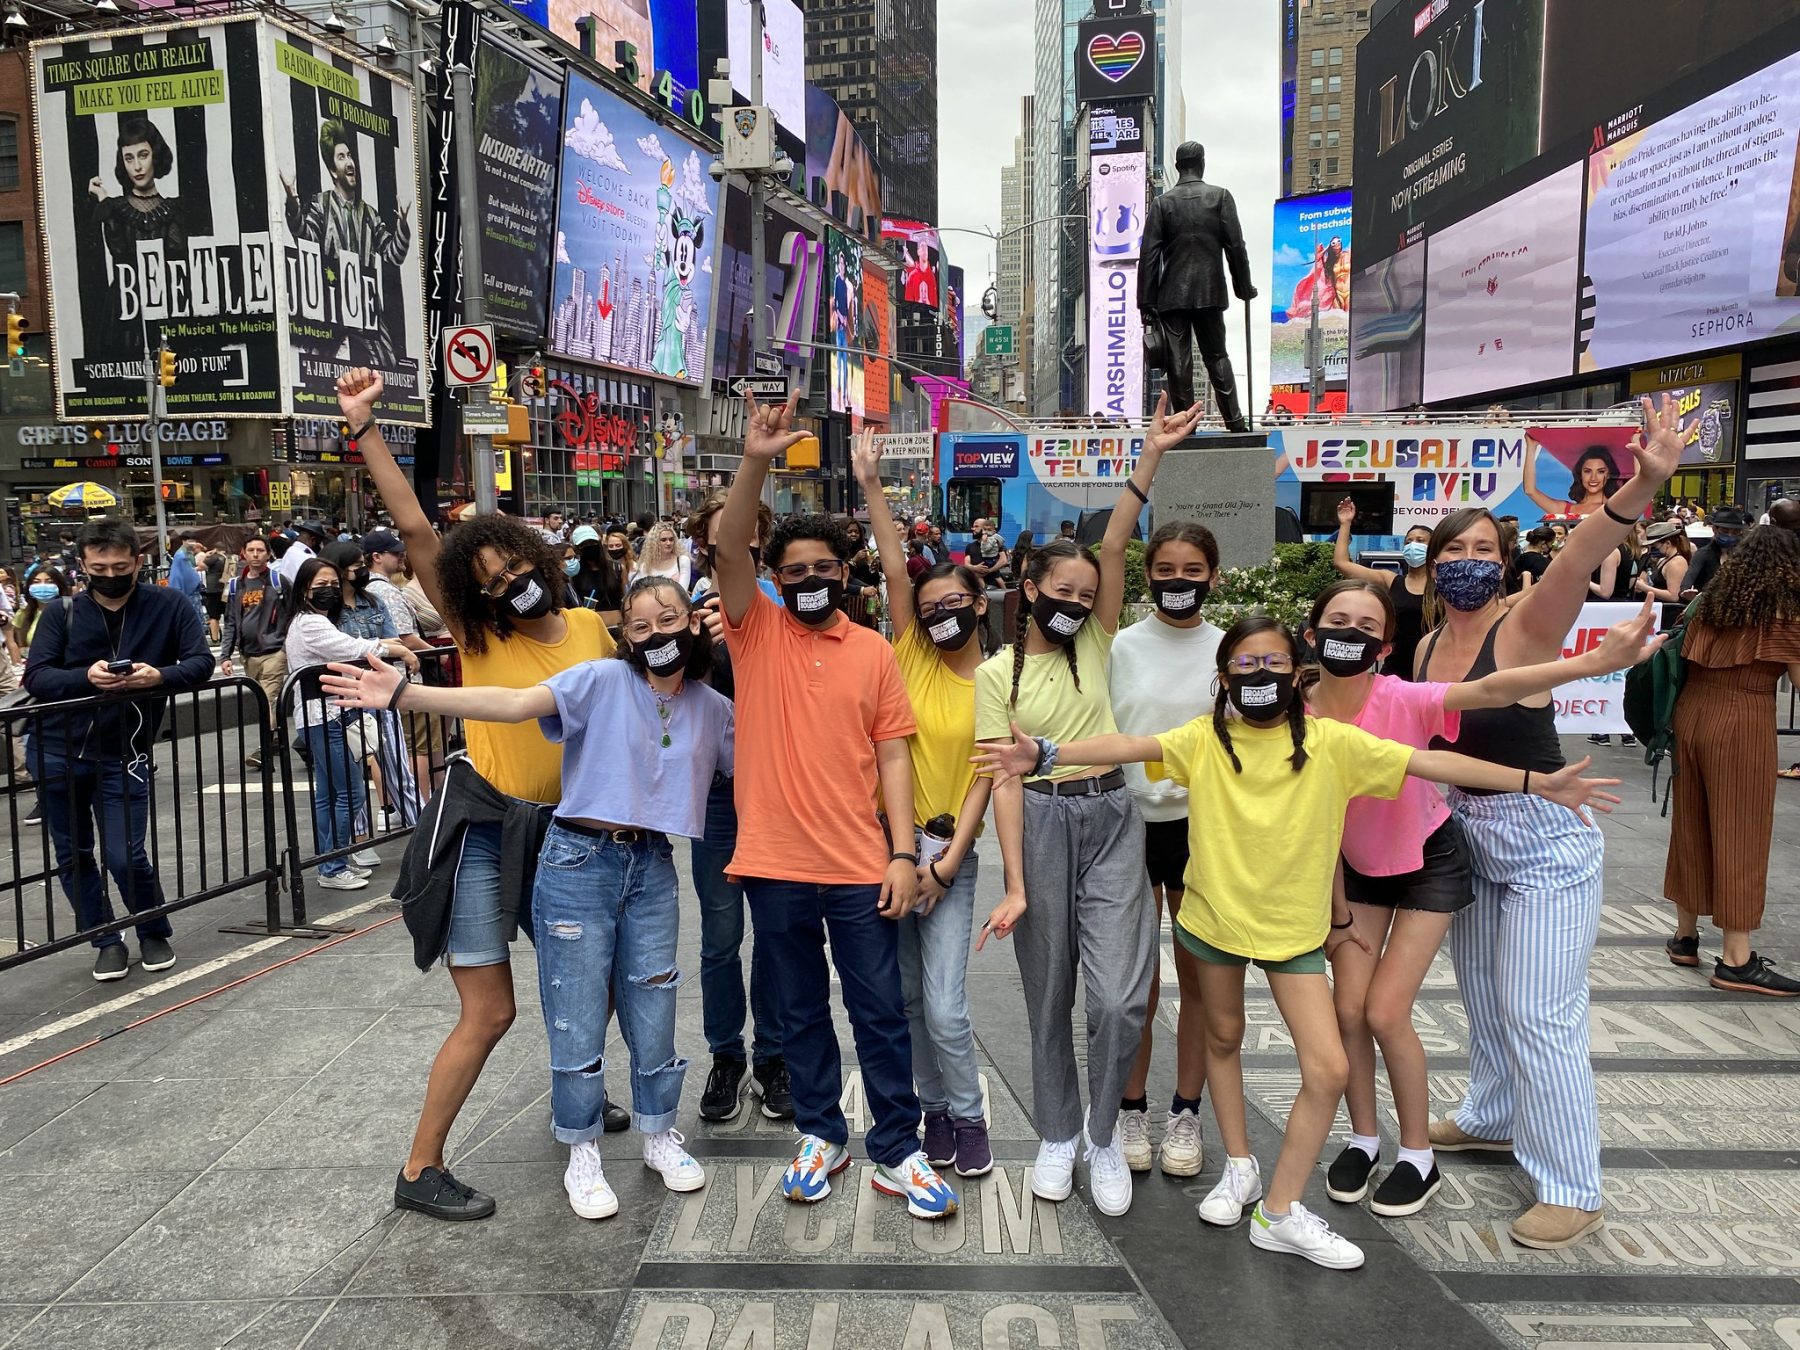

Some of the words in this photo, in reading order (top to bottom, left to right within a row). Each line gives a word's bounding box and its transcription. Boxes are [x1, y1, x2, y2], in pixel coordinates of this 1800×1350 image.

[47, 61, 83, 84] TIMES
[85, 56, 130, 81] SQUARE
[134, 51, 158, 72] CAN
[162, 43, 207, 68] REALLY
[283, 49, 320, 82] RAISING
[321, 68, 354, 98] SPIRITS
[1377, 0, 1485, 158] LOKI
[79, 87, 114, 109] MAKE
[117, 84, 142, 105] YOU
[146, 81, 176, 101] FEEL
[181, 76, 220, 99] ALIVE!
[328, 96, 341, 117] ON
[343, 101, 391, 137] BROADWAY!
[1607, 104, 1643, 130] MARRIOTT
[1607, 119, 1639, 142] MARQUIS
[1627, 155, 1637, 165] me
[1638, 146, 1656, 162] Pride
[1656, 137, 1680, 153] means
[1680, 122, 1706, 142] having
[1707, 117, 1721, 130] the
[1721, 104, 1747, 123] ability
[1749, 99, 1759, 111] to
[478, 133, 552, 181] INSUREARTH
[1403, 155, 1431, 180] ORIGINAL
[1432, 136, 1454, 163] SERIES
[1616, 178, 1624, 188] to
[1624, 171, 1639, 184] take
[1639, 167, 1649, 179] up
[1649, 158, 1668, 175] space
[1668, 151, 1682, 168] just
[1682, 148, 1692, 159] as
[1696, 140, 1709, 153] am
[1710, 124, 1742, 146] without
[1743, 109, 1778, 133] apology
[1112, 164, 1137, 173] Spotify
[1610, 197, 1618, 207] or
[1657, 171, 1671, 187] and
[1671, 159, 1701, 180] without
[1702, 155, 1715, 169] the
[1715, 144, 1741, 163] threat
[1741, 136, 1752, 152] of
[1681, 184, 1690, 195] or
[1734, 155, 1762, 174] means
[1763, 149, 1779, 163] the
[578, 164, 623, 197] WELCOME
[627, 188, 650, 209] BACK
[1391, 187, 1412, 214] NOW
[1412, 152, 1466, 200] STREAMING
[487, 193, 499, 207] But
[530, 210, 538, 222] be
[605, 201, 625, 219] store
[1299, 209, 1323, 221] From
[1648, 210, 1670, 225] ability
[1671, 206, 1680, 216] to
[1680, 197, 1698, 213] truly
[1699, 193, 1710, 206] be
[487, 213, 504, 225] great
[504, 215, 510, 228] if
[509, 219, 520, 231] you
[582, 211, 606, 232] VISIT
[1299, 224, 1310, 233] to
[116, 238, 271, 320] BEETLE
[483, 273, 496, 287] Tell
[495, 280, 503, 289] us
[503, 282, 519, 293] your
[519, 284, 533, 297] plan
[780, 231, 824, 359] 21
[160, 324, 176, 337] The
[219, 321, 238, 334] The
[1691, 311, 1754, 338] SEPHORA
[935, 326, 943, 358] 1500
[1659, 362, 1705, 384] INVICTA
[166, 393, 190, 403] GARDEN
[219, 391, 234, 401] 50TH
[241, 390, 276, 400] BROADWAY
[737, 382, 754, 392] ONE
[762, 382, 781, 392] WAY
[1678, 388, 1701, 417] EALS
[17, 424, 89, 446] GIFTS
[897, 437, 913, 446] FLOW
[914, 436, 930, 445] ZONE
[85, 457, 118, 467] Canon
[891, 447, 907, 456] KEEP
[908, 446, 930, 455] MOVING
[956, 452, 1015, 464] TOPVIEW
[1045, 459, 1090, 477] TEL
[271, 483, 279, 506] ATM
[1224, 501, 1237, 509] Old
[1600, 1174, 1754, 1215] BOX
